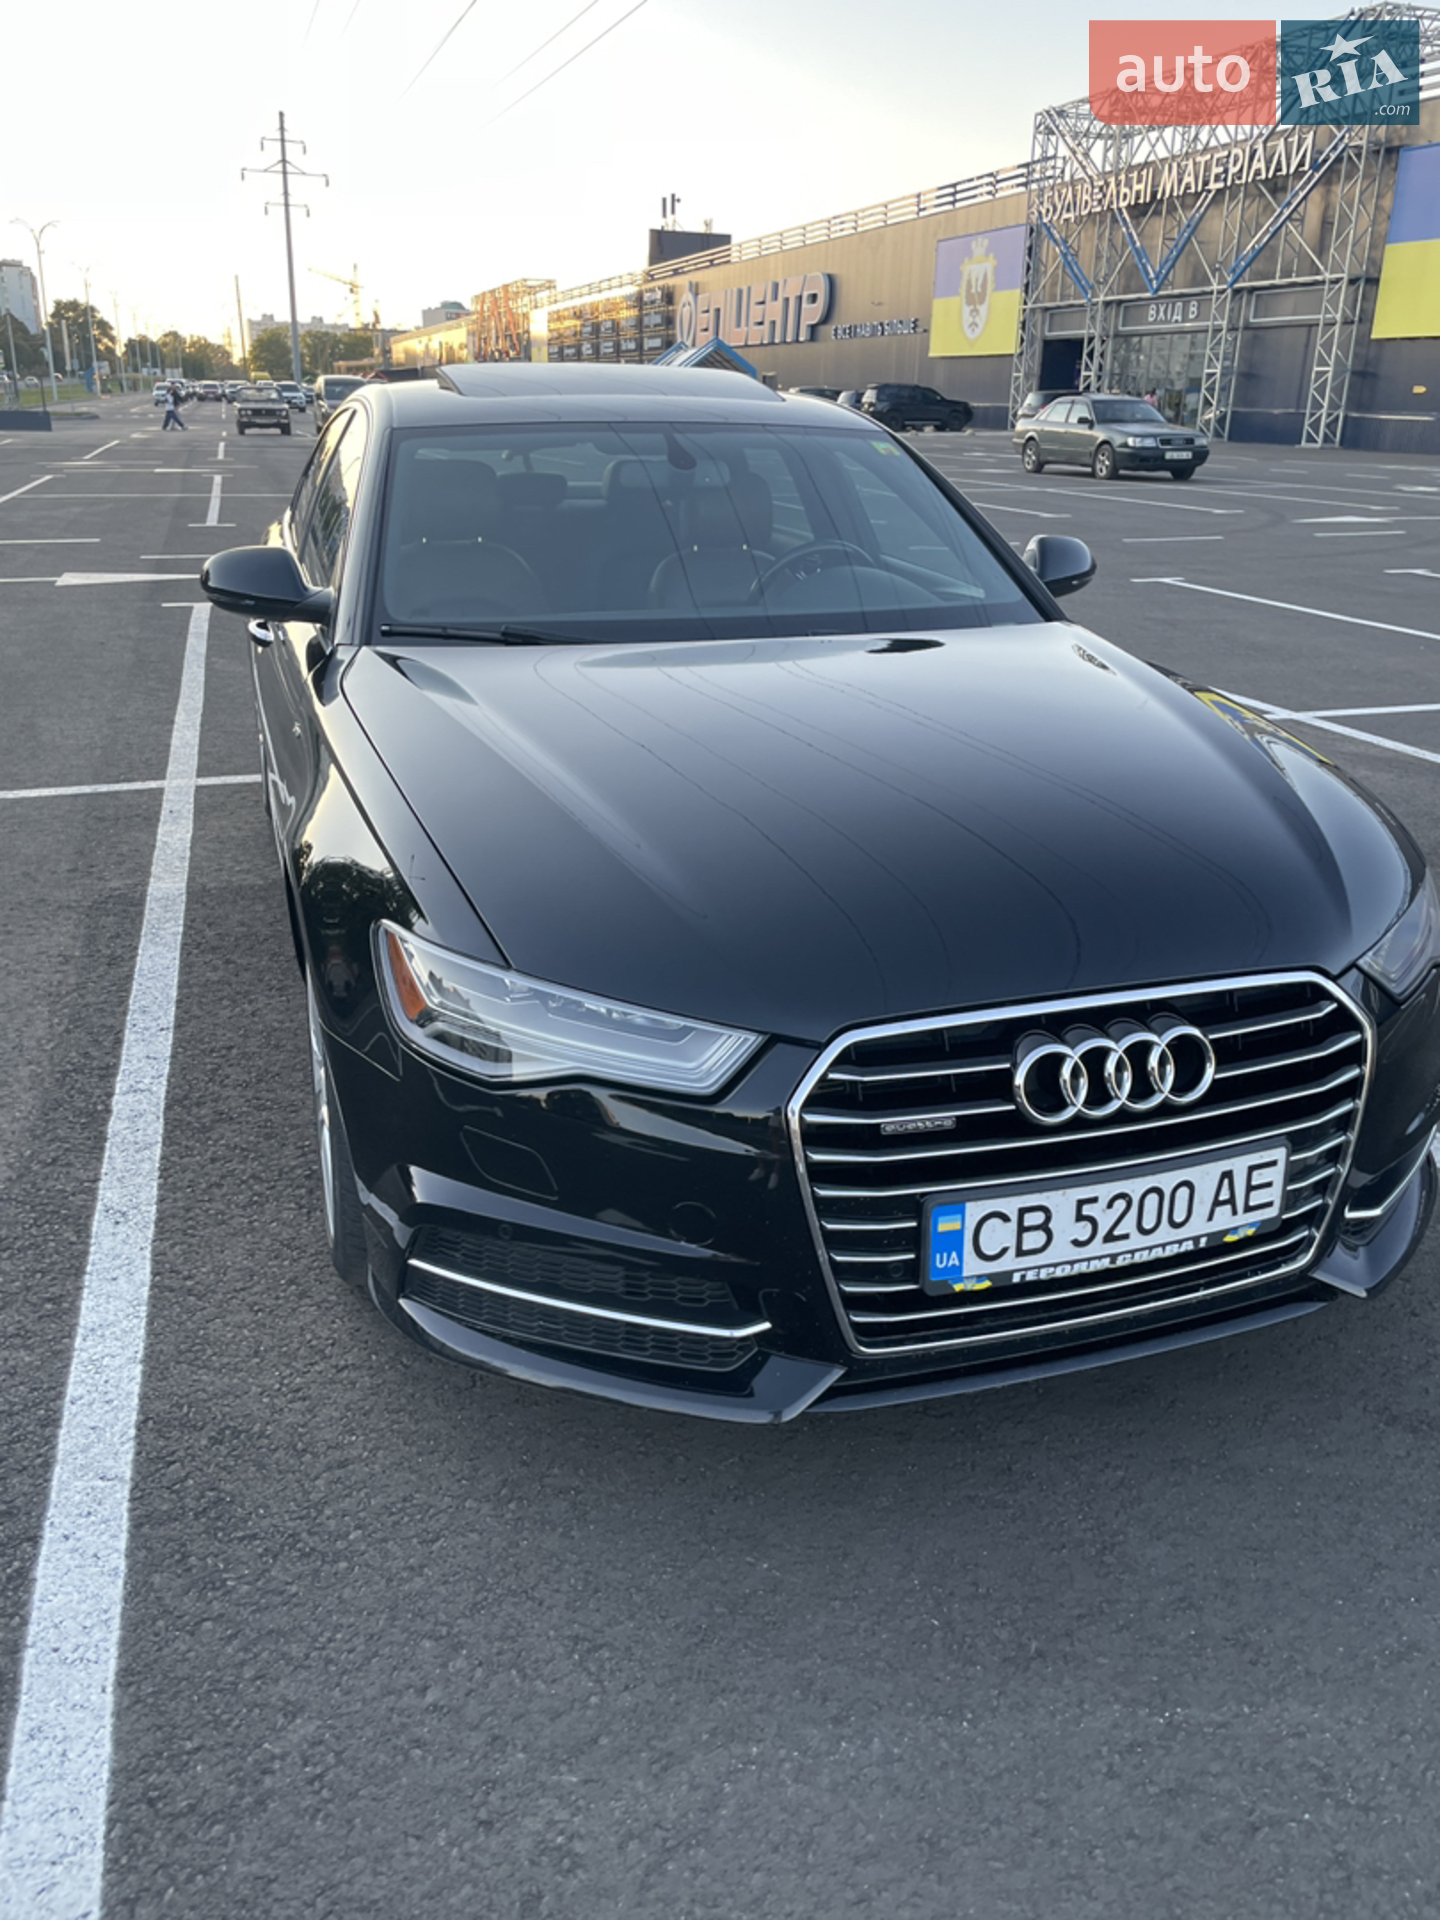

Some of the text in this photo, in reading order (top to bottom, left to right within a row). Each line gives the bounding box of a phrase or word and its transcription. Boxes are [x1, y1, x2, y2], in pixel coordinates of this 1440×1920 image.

[1043, 131, 1315, 224] БУДІВЕЛЬНІ МАТЕРІАЛИ
[1147, 300, 1199, 323] ВХІД В
[971, 1158, 1280, 1263] CB 5200 AE
[935, 1251, 960, 1269] UA
[1011, 1256, 1111, 1283] ГЕРОЯМ
